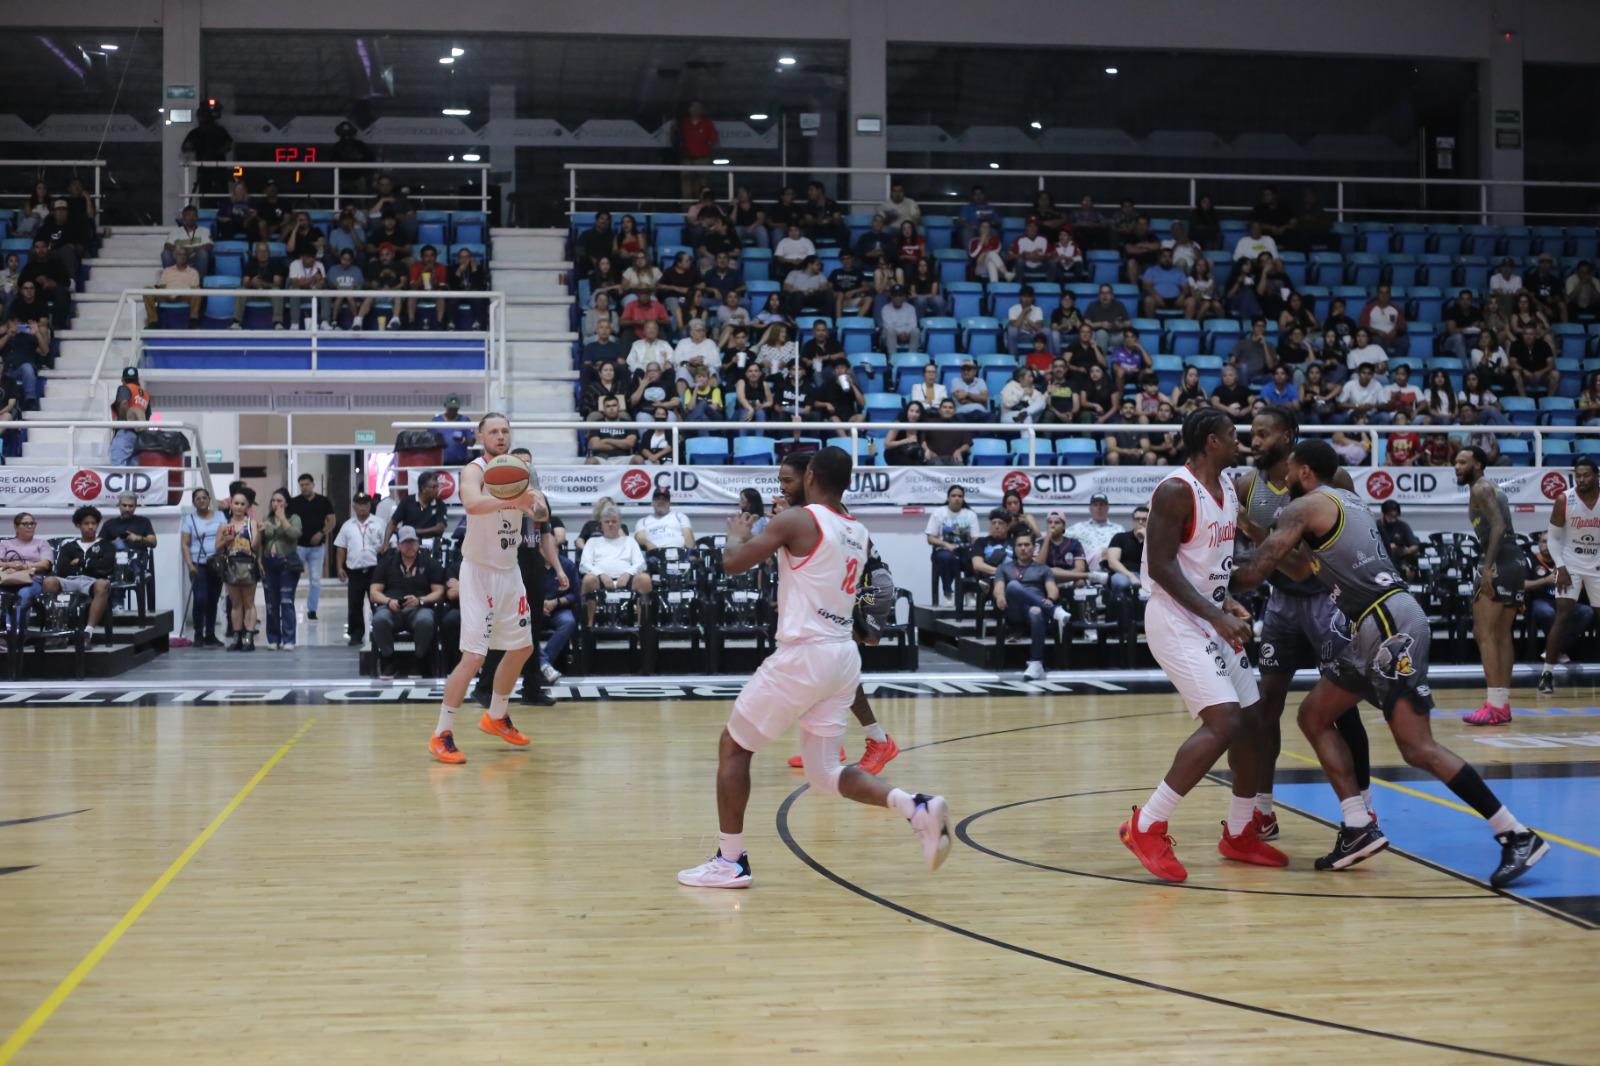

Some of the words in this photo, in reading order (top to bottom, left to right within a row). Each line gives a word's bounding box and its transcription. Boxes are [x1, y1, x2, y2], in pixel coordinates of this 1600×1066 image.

[104, 472, 151, 493] CID
[654, 471, 699, 491] CID
[905, 476, 942, 484] SIEMPRE
[945, 476, 986, 485] GRANDES
[1034, 473, 1076, 493] CID
[1092, 476, 1128, 484] SIEMPRE
[1396, 473, 1437, 492] CID
[18, 486, 50, 494] LOBOS
